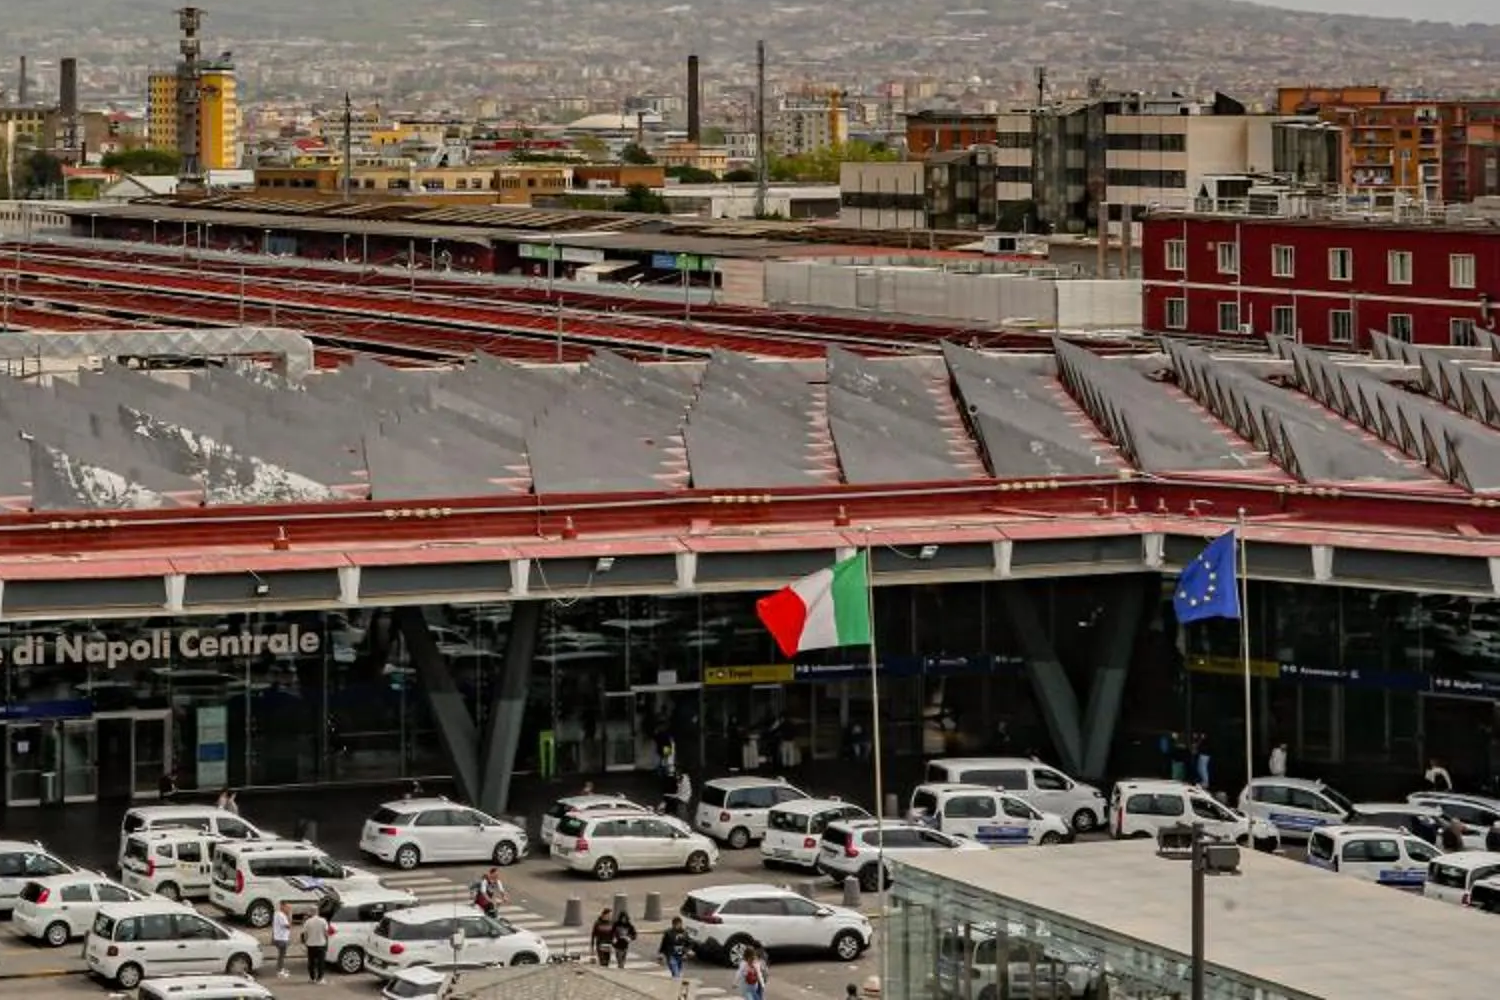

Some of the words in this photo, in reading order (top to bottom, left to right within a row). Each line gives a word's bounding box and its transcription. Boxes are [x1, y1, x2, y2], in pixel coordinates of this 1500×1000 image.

[12, 635, 45, 665] di
[55, 629, 171, 669] Napoli
[179, 623, 320, 659] Centrale
